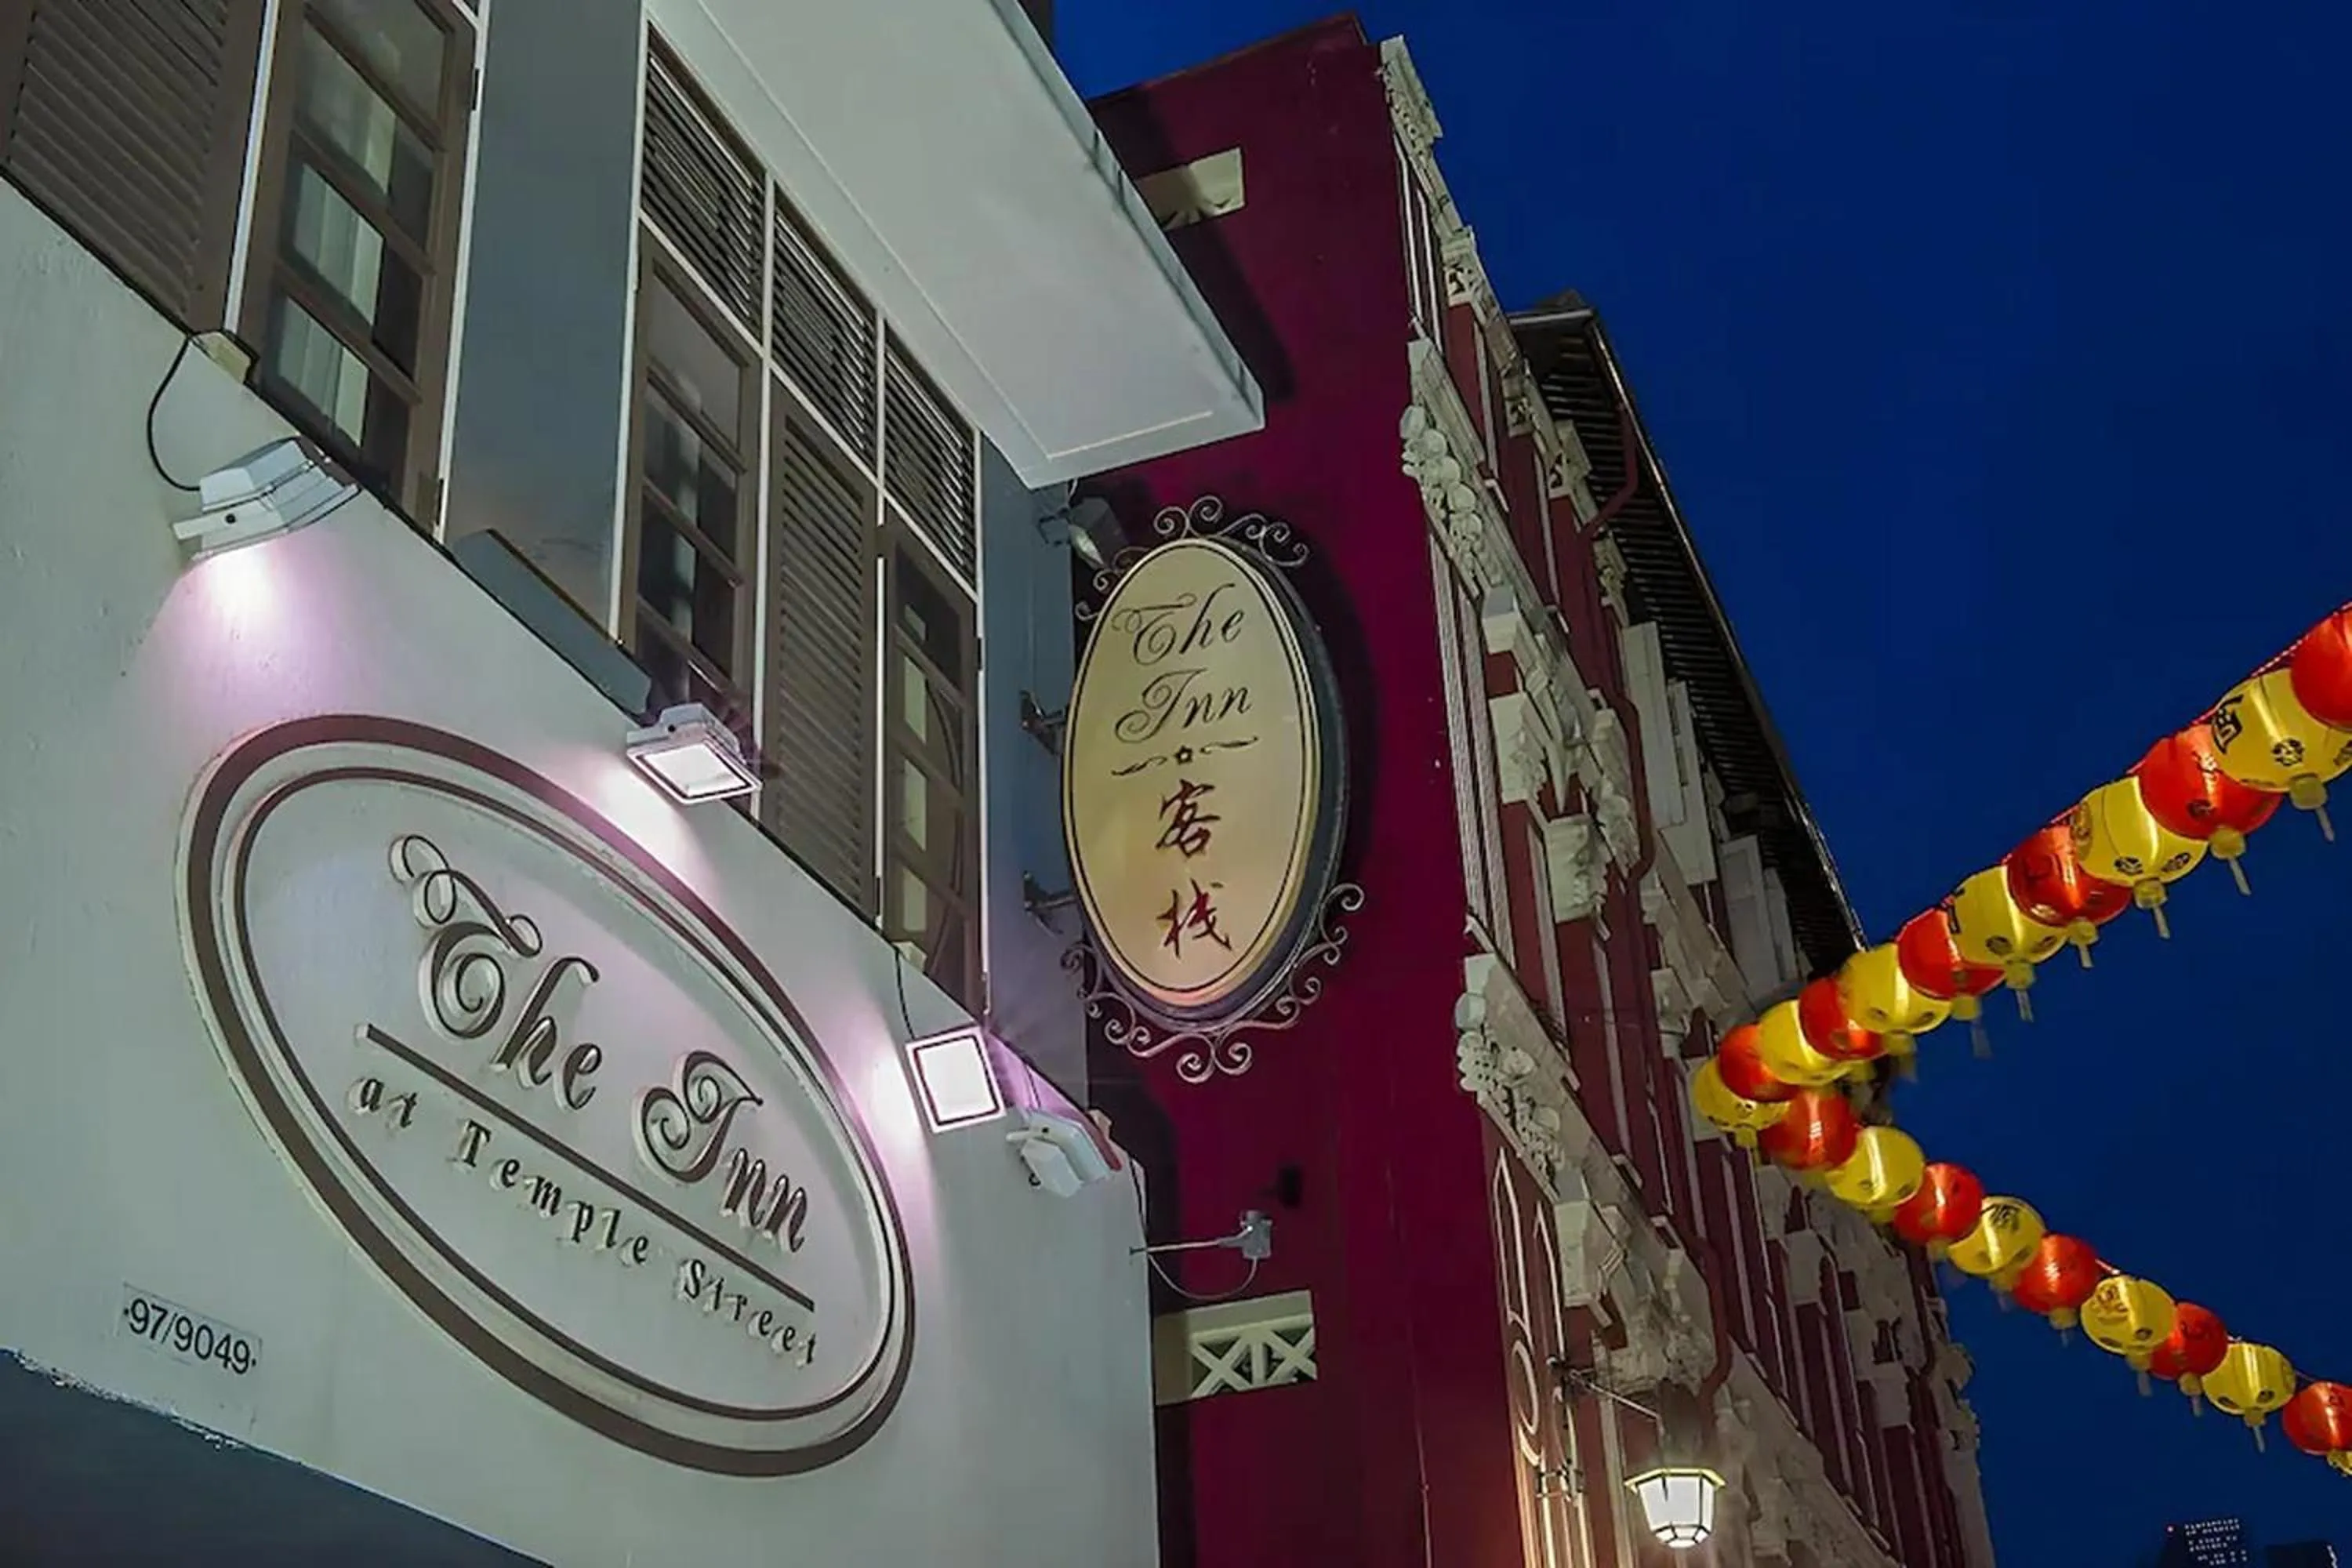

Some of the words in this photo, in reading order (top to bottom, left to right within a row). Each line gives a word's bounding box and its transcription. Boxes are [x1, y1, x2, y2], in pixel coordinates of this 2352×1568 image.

[1111, 583, 1246, 666] The
[1114, 666, 1252, 744] Inn
[1155, 779, 1232, 959] 客栈
[390, 833, 602, 1111] The
[632, 1050, 808, 1253] Inn
[349, 1075, 417, 1129] at
[447, 1116, 649, 1266] Temple
[677, 1258, 817, 1367] Street
